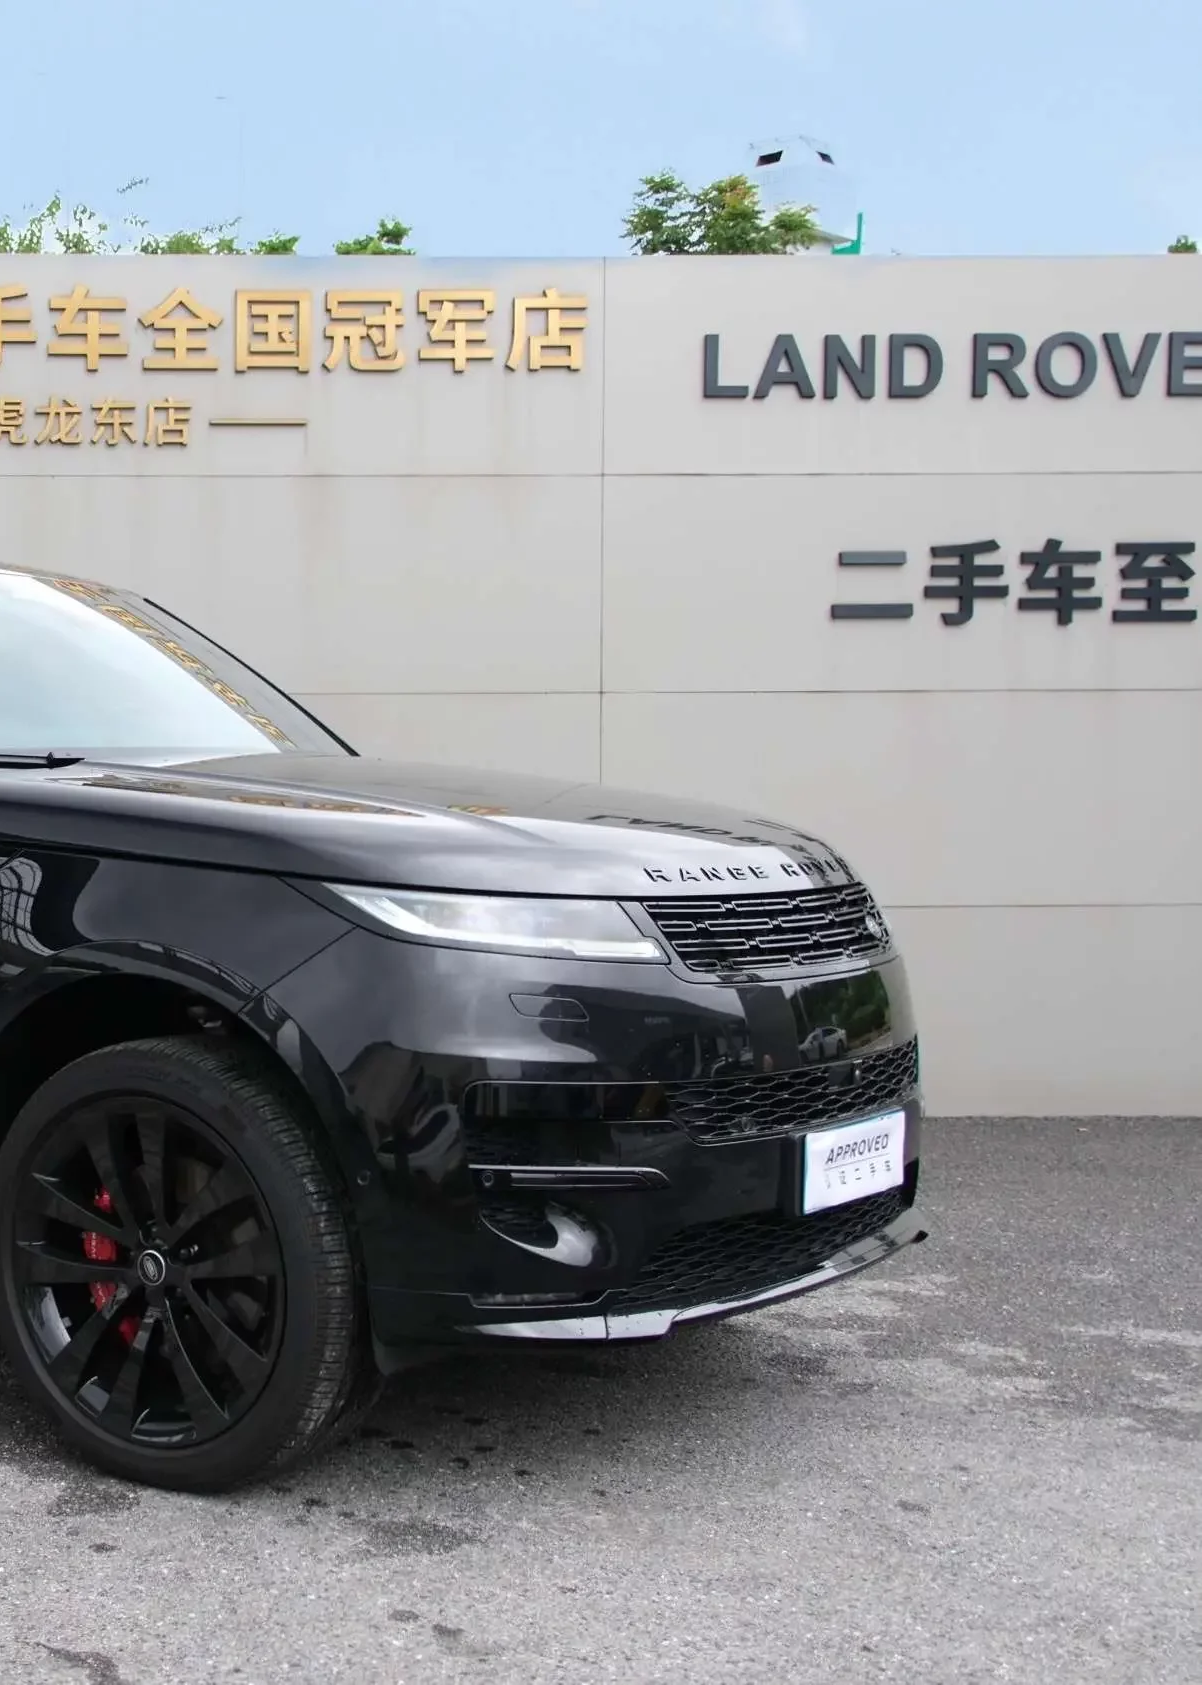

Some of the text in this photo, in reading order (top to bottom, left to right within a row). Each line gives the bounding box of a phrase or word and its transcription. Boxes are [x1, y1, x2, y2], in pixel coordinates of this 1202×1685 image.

[702, 330, 1202, 400] LAND ROVE
[829, 537, 1198, 627] 二手车至
[825, 1133, 890, 1165] APPROVED
